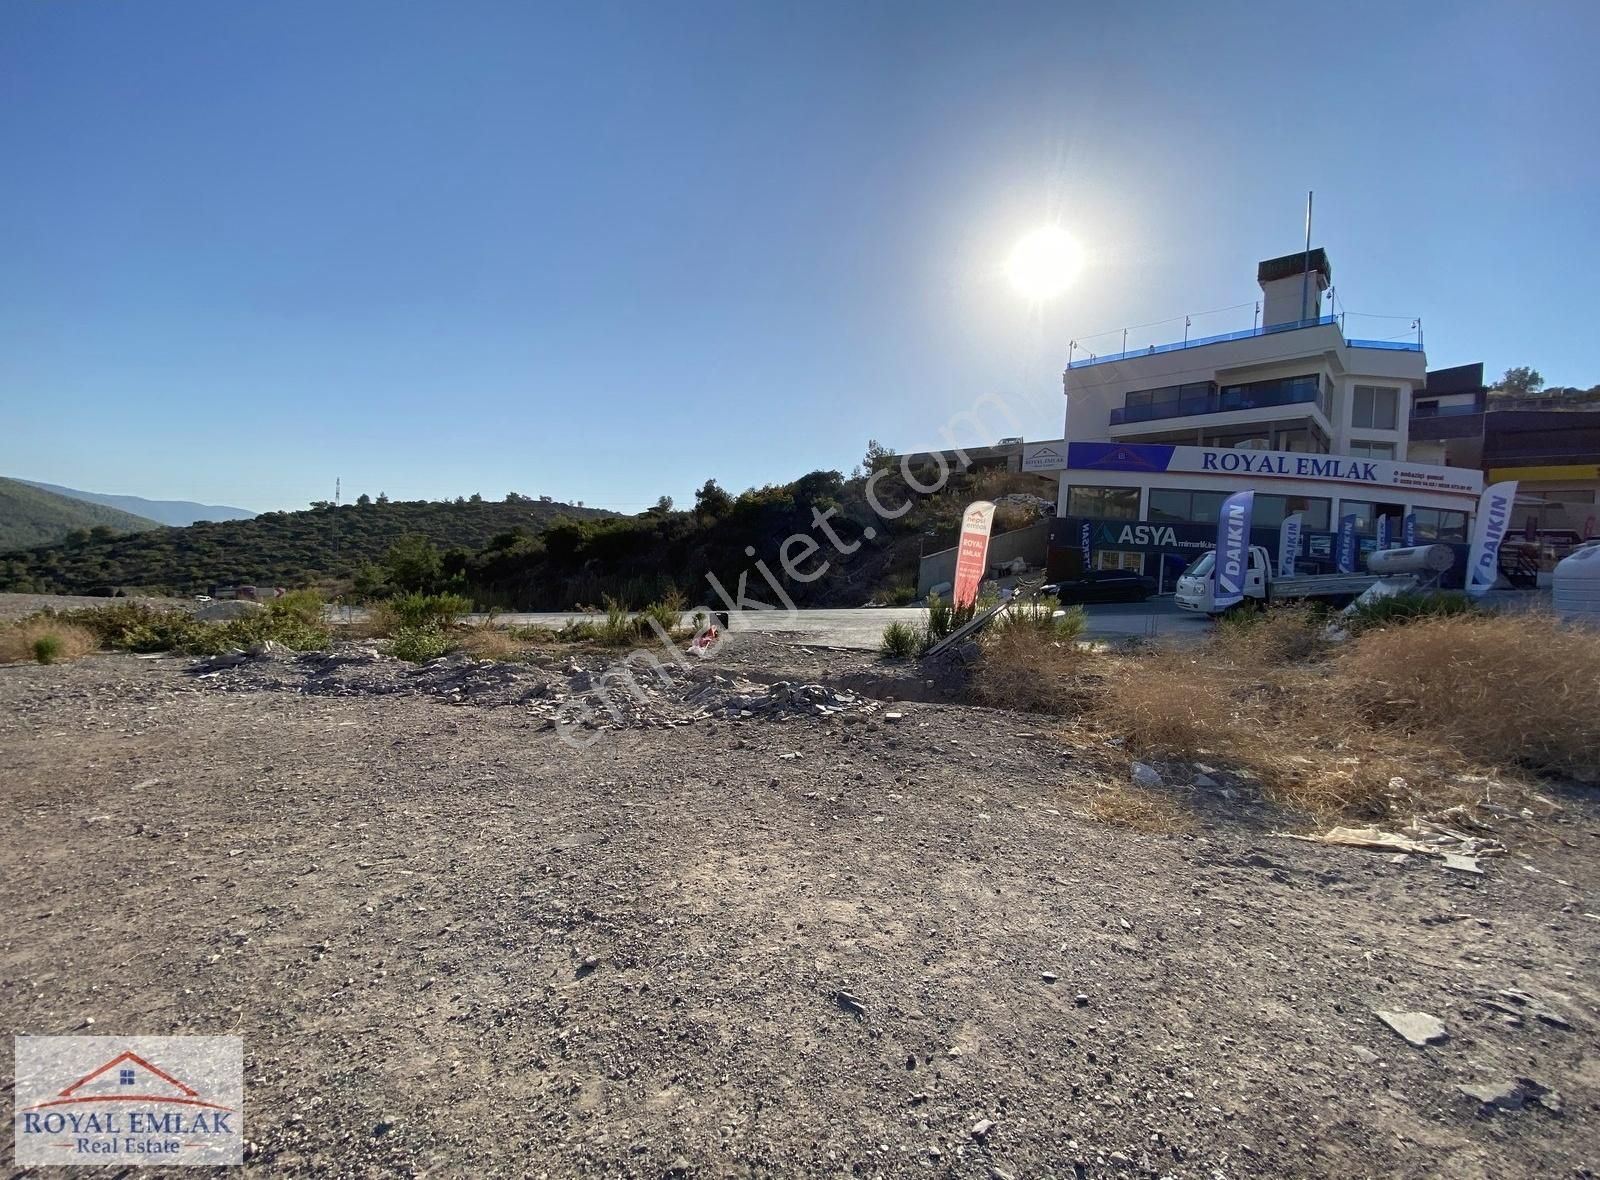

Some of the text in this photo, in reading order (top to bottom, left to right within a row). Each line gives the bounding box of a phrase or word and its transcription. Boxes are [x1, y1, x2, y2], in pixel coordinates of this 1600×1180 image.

[1202, 452, 1378, 481] ROYAL EMLAK
[963, 538, 984, 548] ROYAL
[1117, 525, 1178, 547] ASYA
[1225, 504, 1245, 576] DAIKIN
[1285, 523, 1298, 565] DAIKIN
[1341, 522, 1354, 564] DAIKIN
[1479, 495, 1508, 569] DAIKIN
[962, 549, 982, 558] EMLAK
